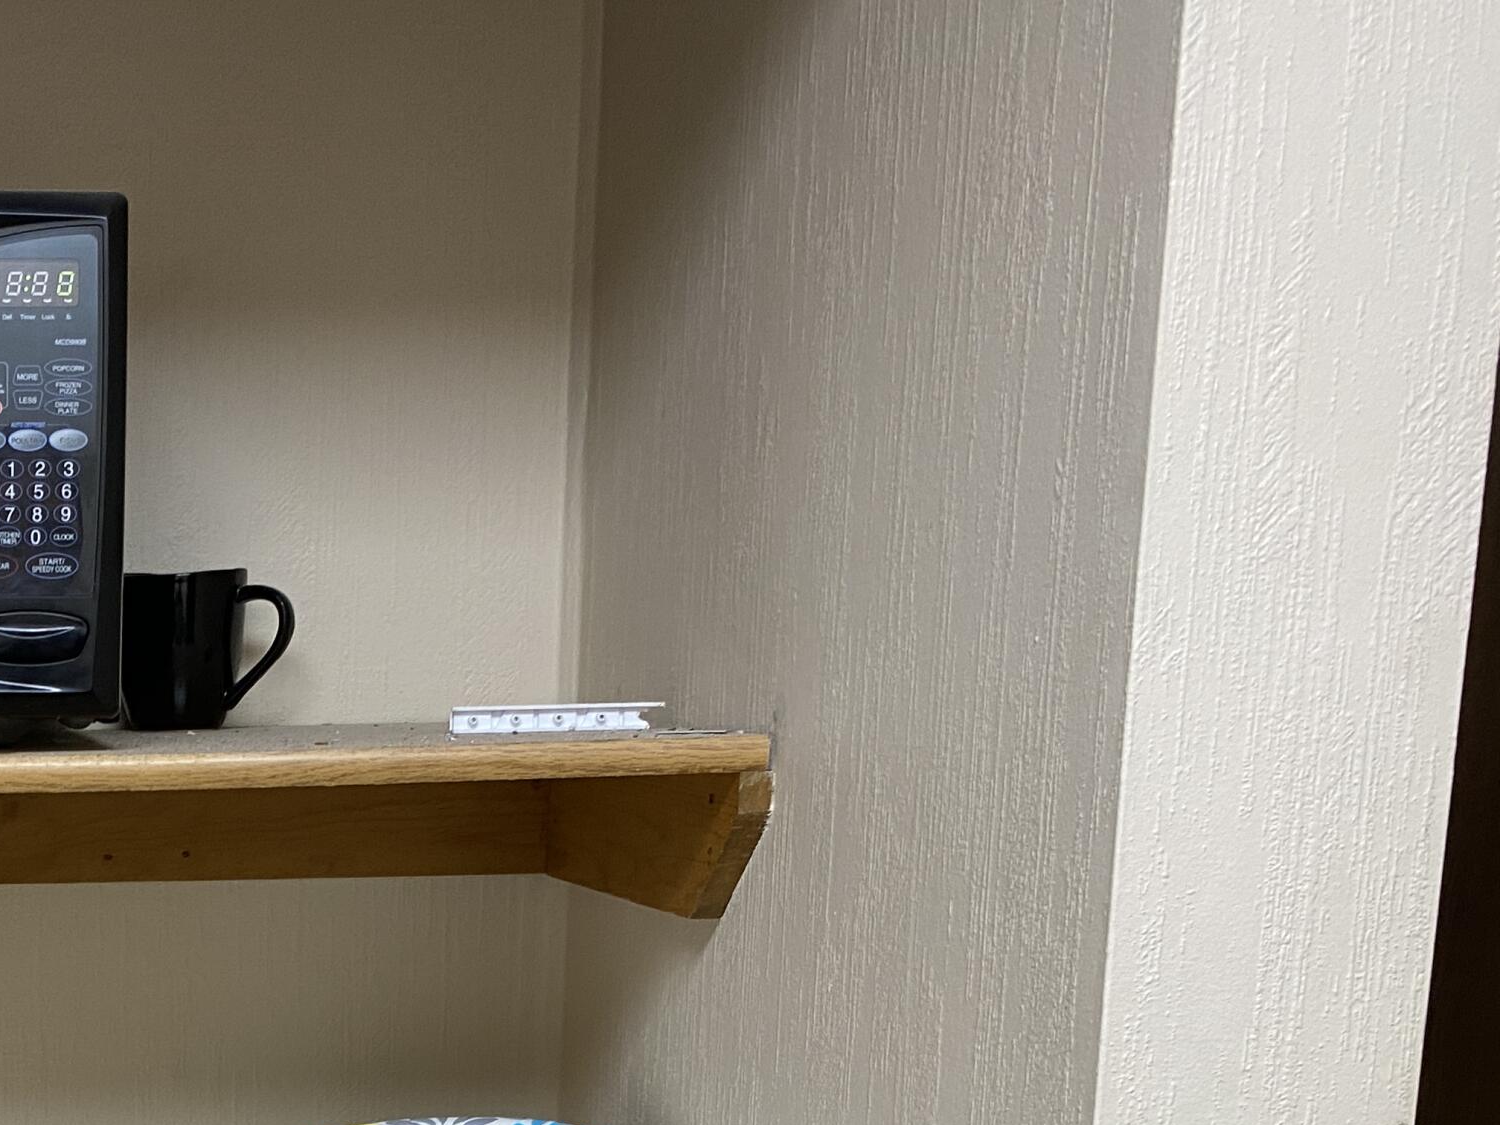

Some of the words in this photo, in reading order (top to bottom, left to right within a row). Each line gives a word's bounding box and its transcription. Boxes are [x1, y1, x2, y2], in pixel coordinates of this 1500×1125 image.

[20, 313, 37, 321] Timer
[16, 373, 39, 382] MORE
[55, 381, 82, 389] FROZEN
[18, 396, 37, 405] LESS
[57, 407, 78, 415] PLATE
[7, 461, 15, 478] 1
[35, 461, 46, 477] 2
[63, 461, 74, 477] 3
[4, 484, 16, 500] 4
[33, 484, 44, 500] 5
[61, 484, 72, 500] 6
[4, 507, 15, 523] 7
[32, 507, 43, 523] 8
[60, 507, 71, 523] 9
[30, 529, 41, 545] 0
[31, 565, 54, 573] SPEEDY
[55, 565, 72, 573] COOK
[39, 557, 66, 566] START/
